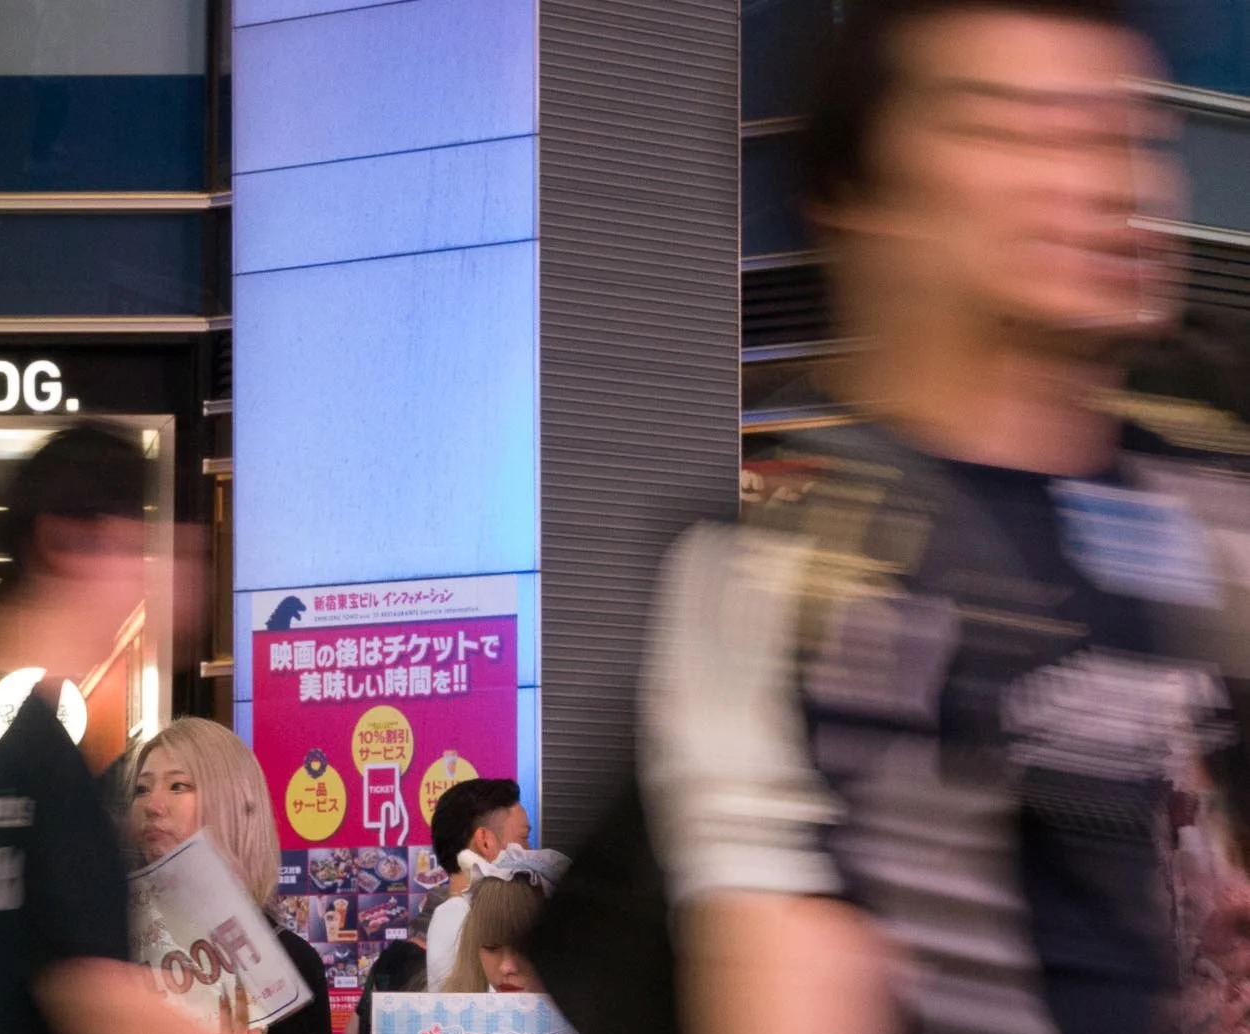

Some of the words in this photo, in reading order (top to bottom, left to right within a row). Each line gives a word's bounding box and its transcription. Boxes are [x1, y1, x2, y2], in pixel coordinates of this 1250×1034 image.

[314, 592, 378, 612] 新宿東宝ビル
[269, 630, 501, 671] 映画の後はチケットで
[358, 729, 409, 744] 10%割引
[358, 745, 407, 761] サービス
[304, 784, 327, 798] 一品
[369, 785, 395, 795] TICKET
[292, 798, 339, 814] サービス
